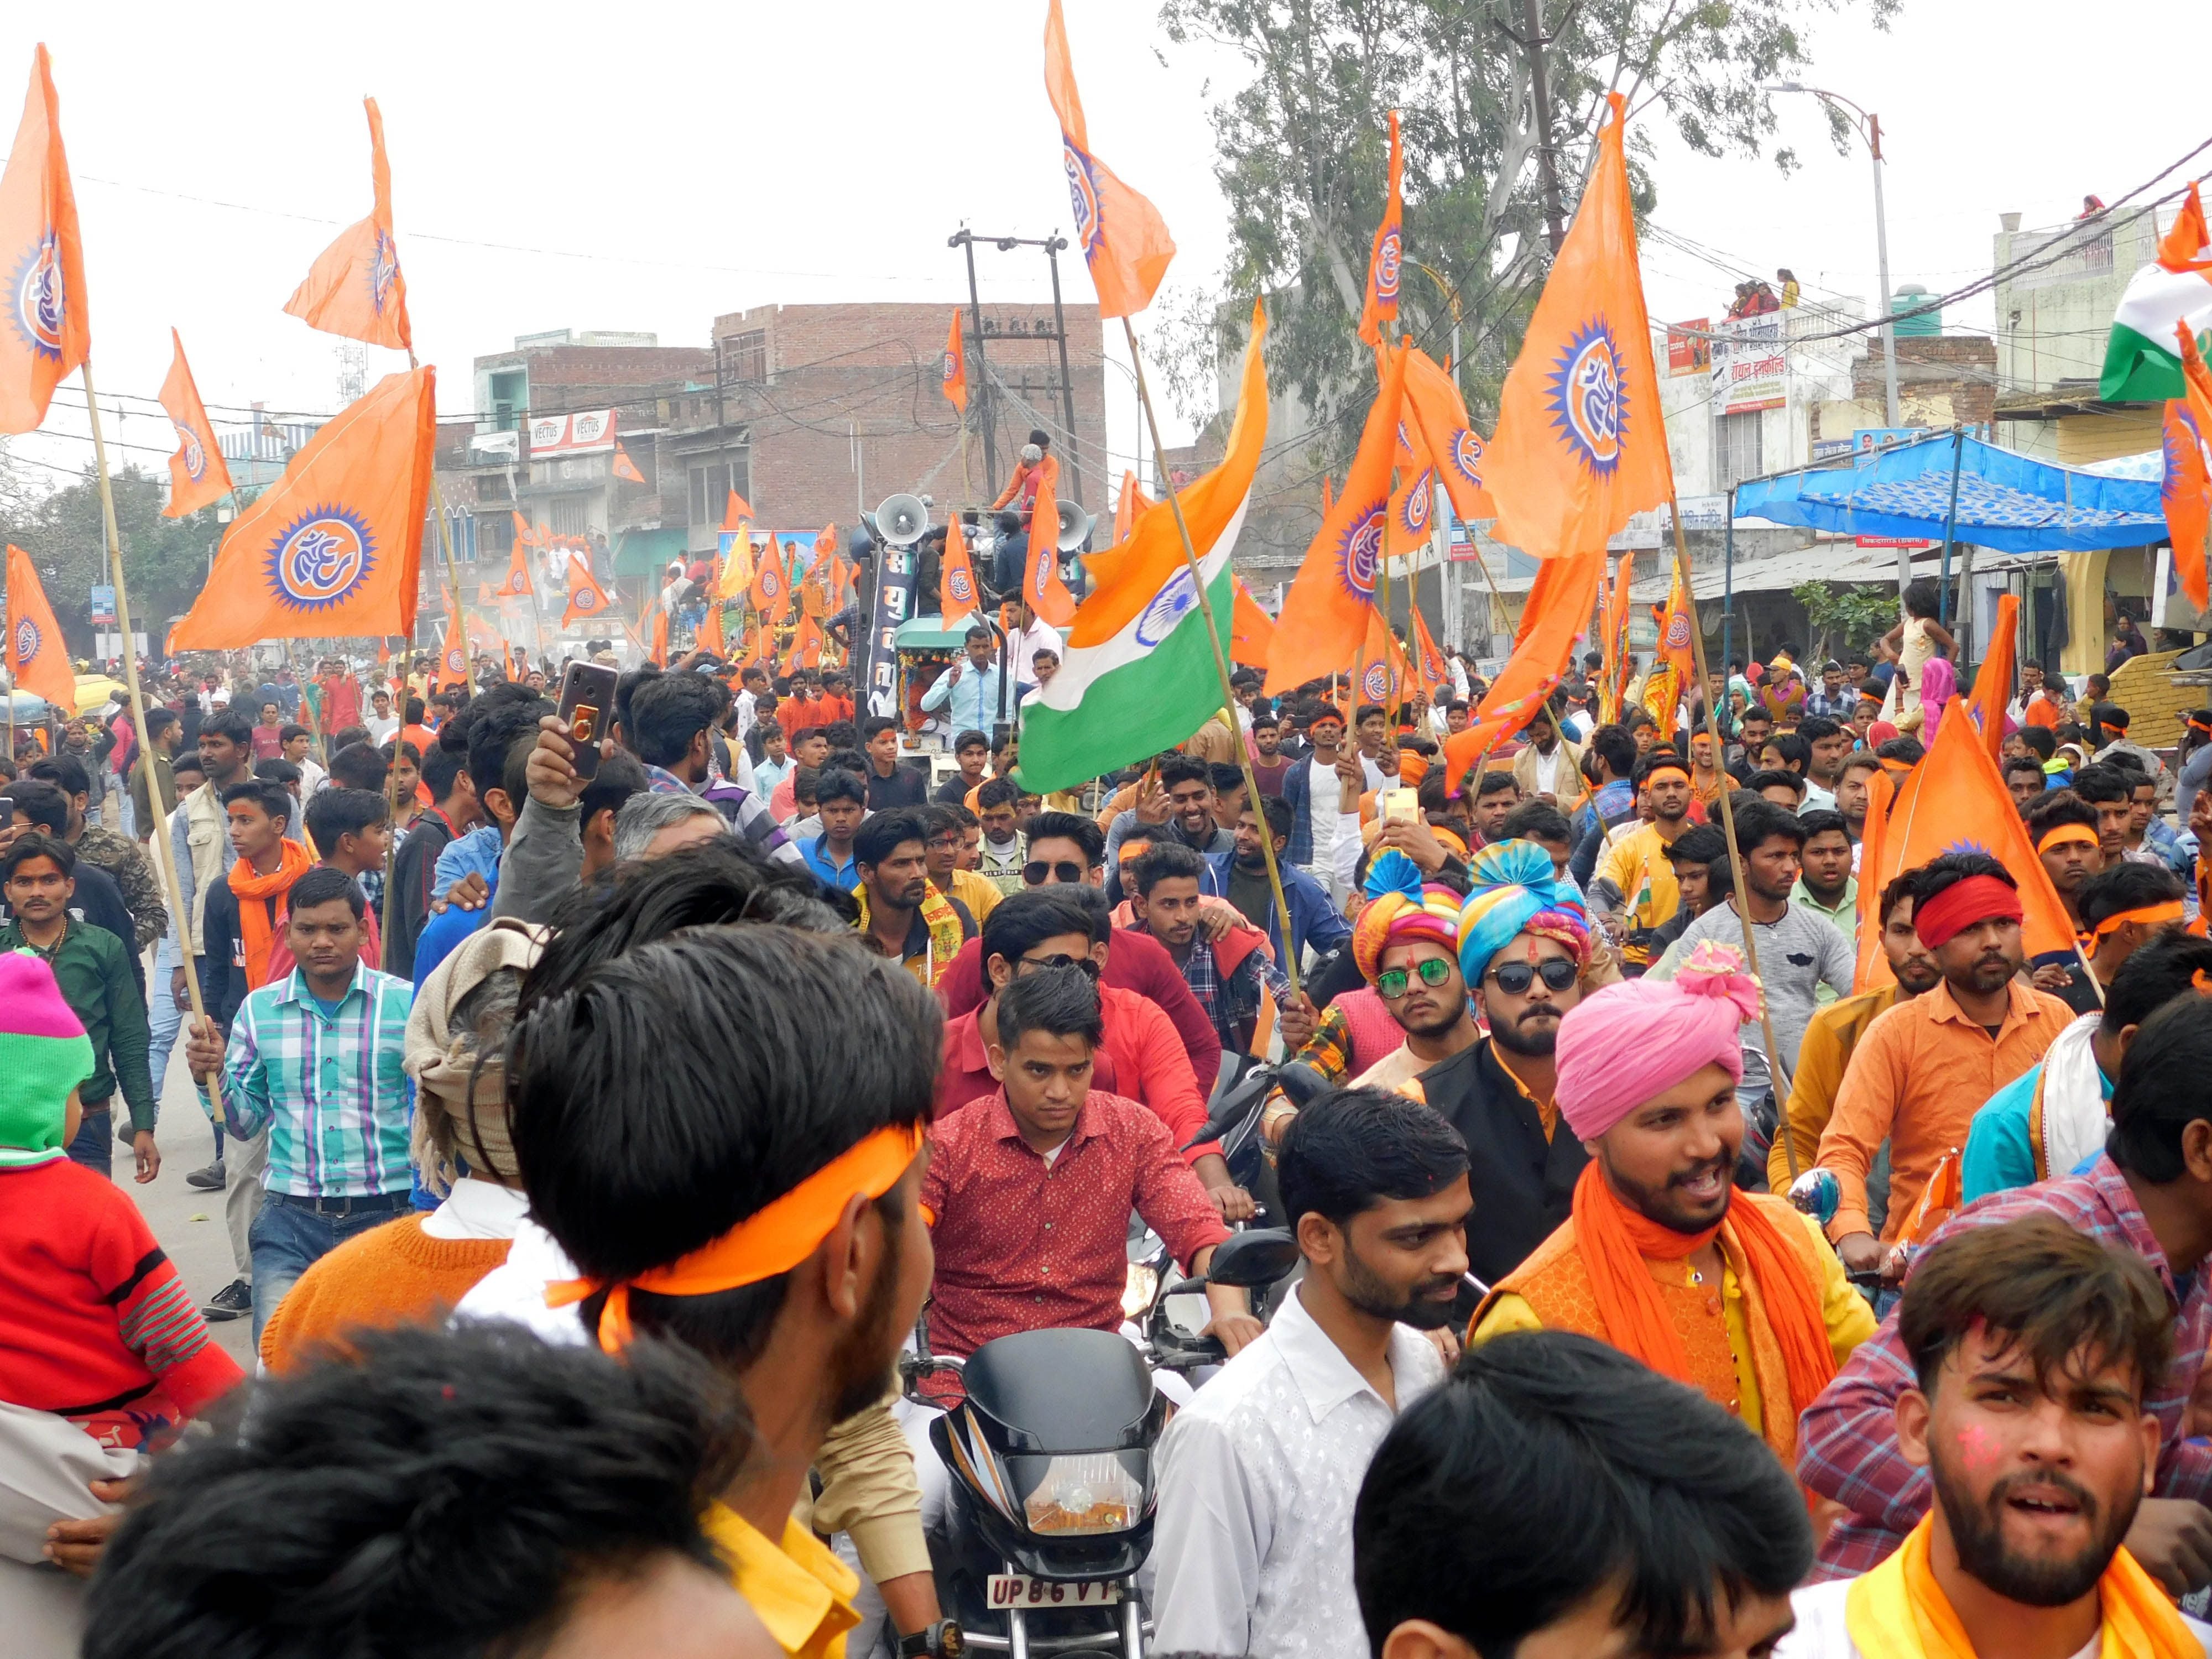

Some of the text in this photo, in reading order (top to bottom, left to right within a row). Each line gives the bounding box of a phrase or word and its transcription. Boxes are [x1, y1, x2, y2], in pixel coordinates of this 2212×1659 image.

[535, 426, 557, 439] VECTUS
[576, 420, 599, 434] VECTUS
[993, 1579, 1024, 1604] UP
